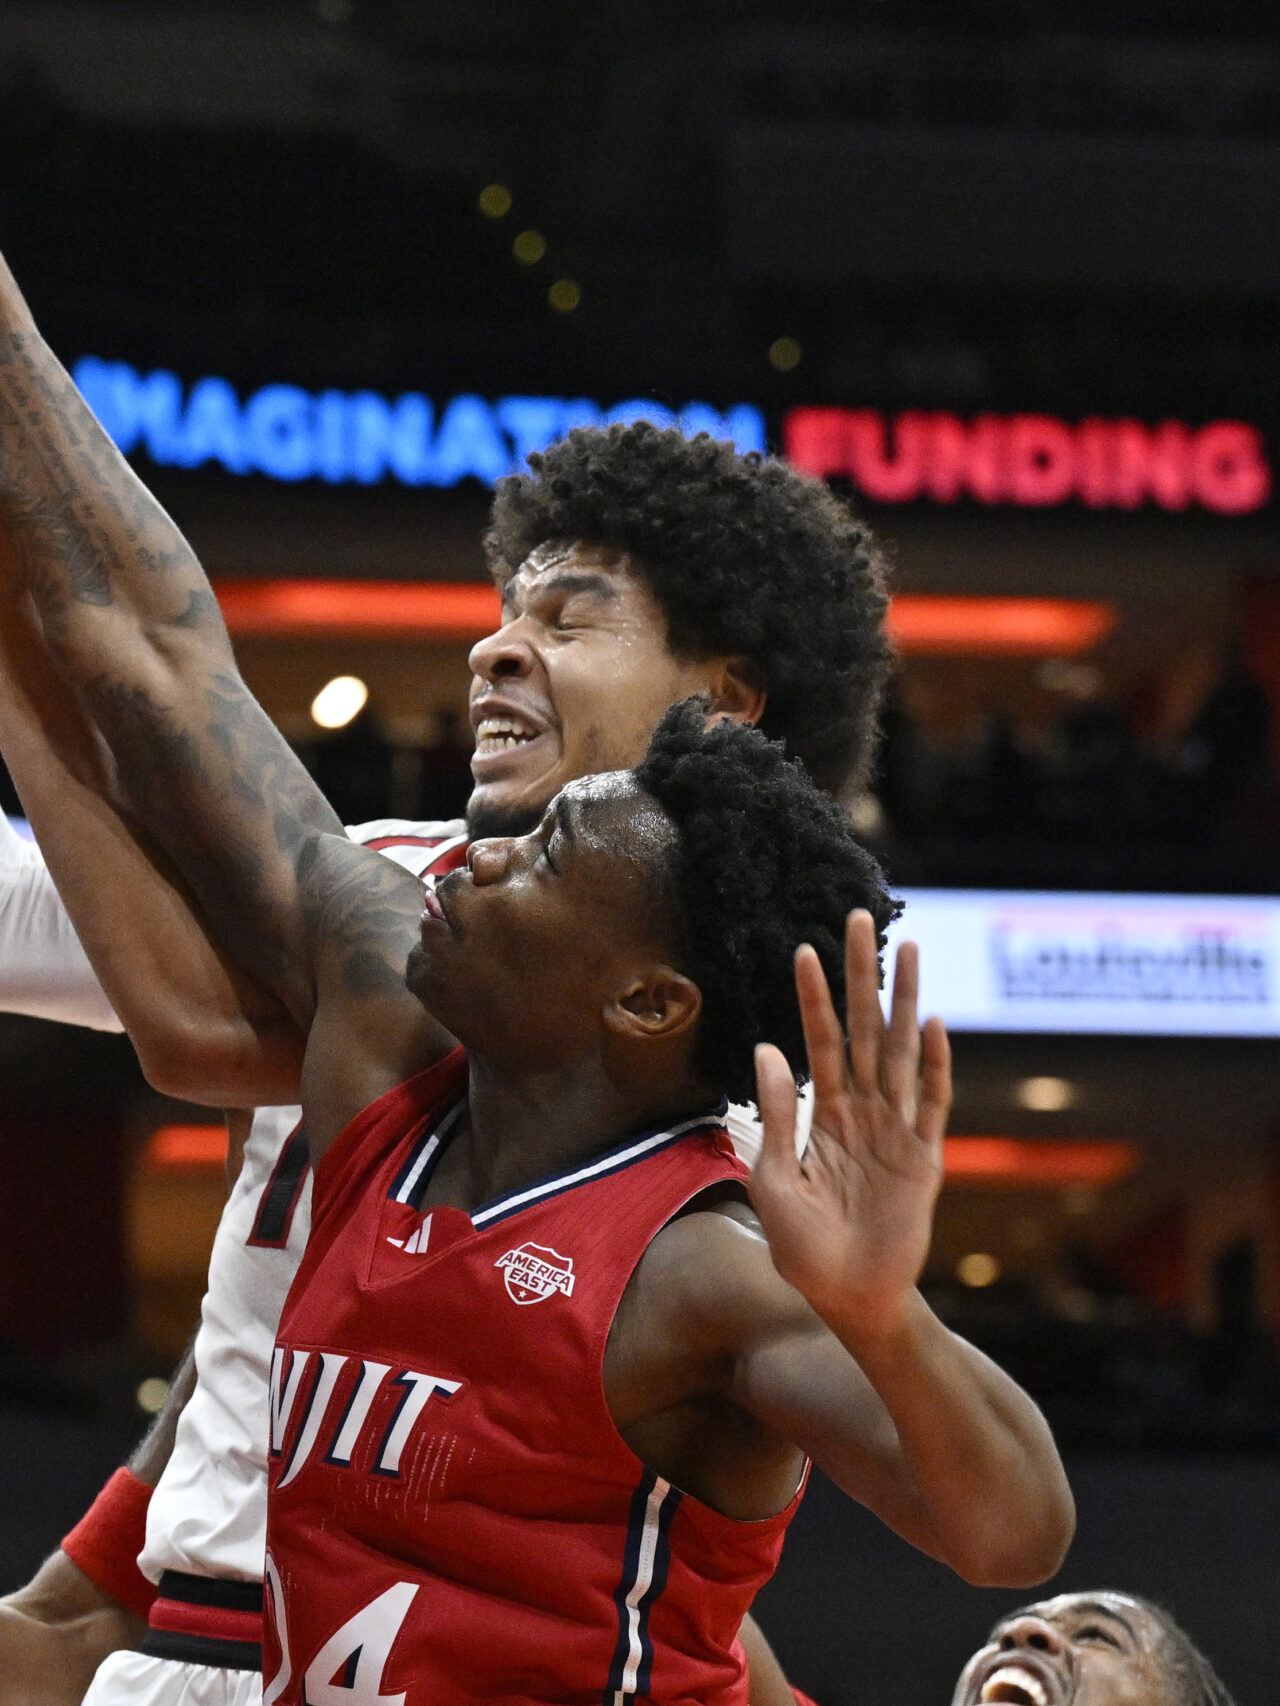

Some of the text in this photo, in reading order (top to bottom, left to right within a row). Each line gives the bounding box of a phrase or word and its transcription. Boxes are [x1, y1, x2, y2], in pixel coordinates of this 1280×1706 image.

[783, 405, 1269, 516] FUNDING
[498, 1251, 571, 1293] AMERICA
[508, 1267, 552, 1293] EAST
[270, 1346, 463, 1489] NJIT
